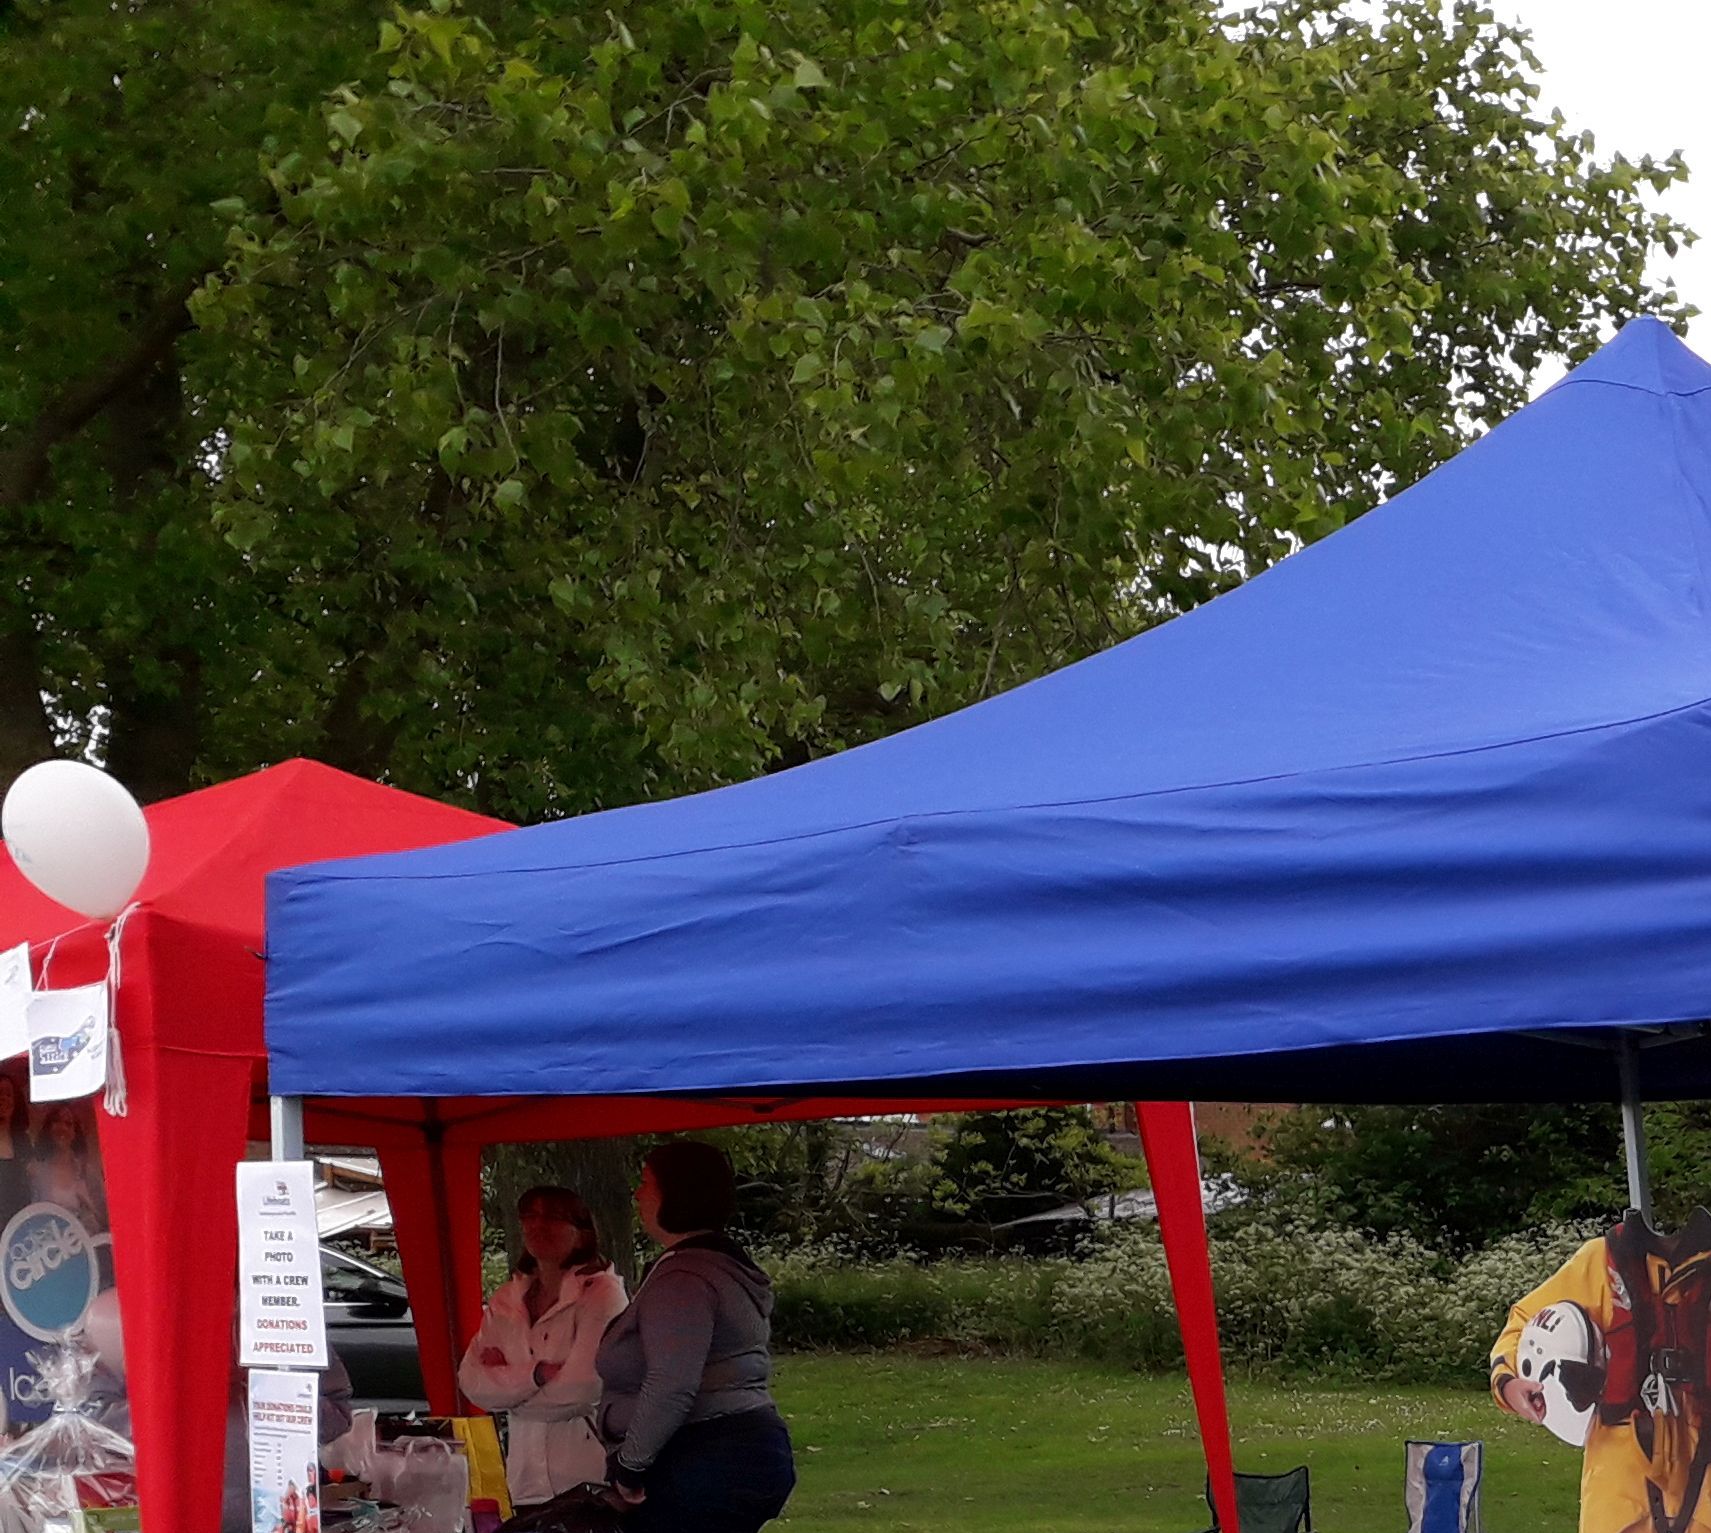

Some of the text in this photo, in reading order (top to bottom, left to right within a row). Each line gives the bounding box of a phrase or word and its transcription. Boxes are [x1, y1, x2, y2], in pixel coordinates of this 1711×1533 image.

[263, 1230, 293, 1241] TAKE A
[264, 1252, 294, 1262] PHOTO
[251, 1275, 309, 1286] WITH A CREW
[257, 1319, 308, 1330] DONATIONS
[252, 1342, 314, 1354] APPRECIATED
